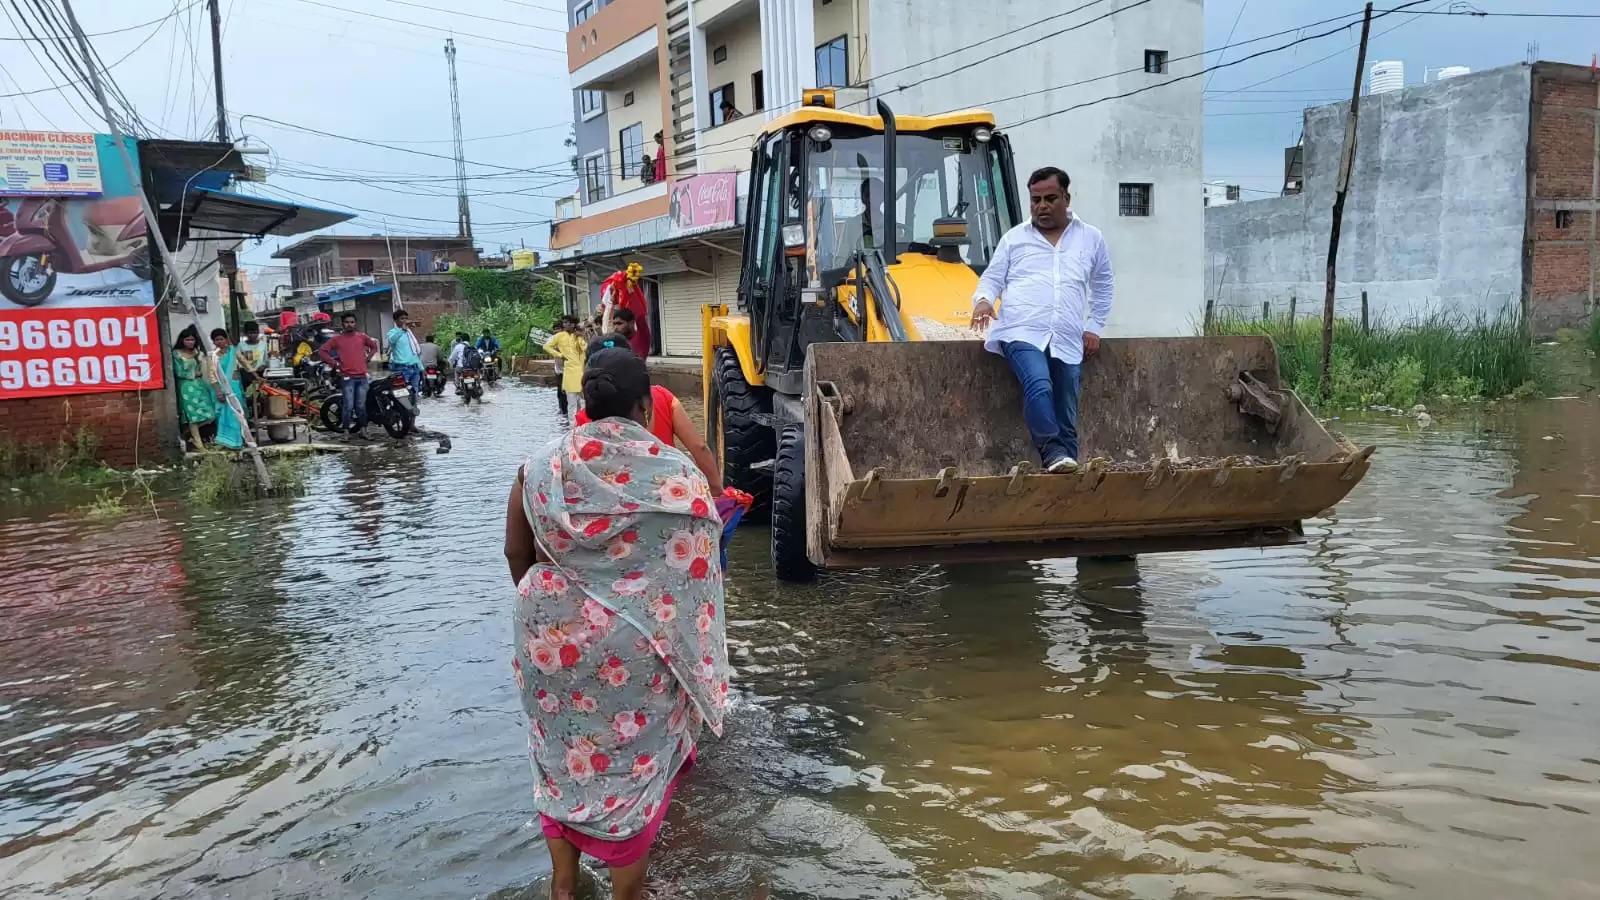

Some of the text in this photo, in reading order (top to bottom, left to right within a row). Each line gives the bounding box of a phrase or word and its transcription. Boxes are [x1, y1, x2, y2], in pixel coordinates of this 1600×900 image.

[48, 133, 94, 144] CLASSES
[65, 288, 141, 297] Jupiter
[0, 317, 148, 351] 966004
[0, 354, 151, 390] 966005
